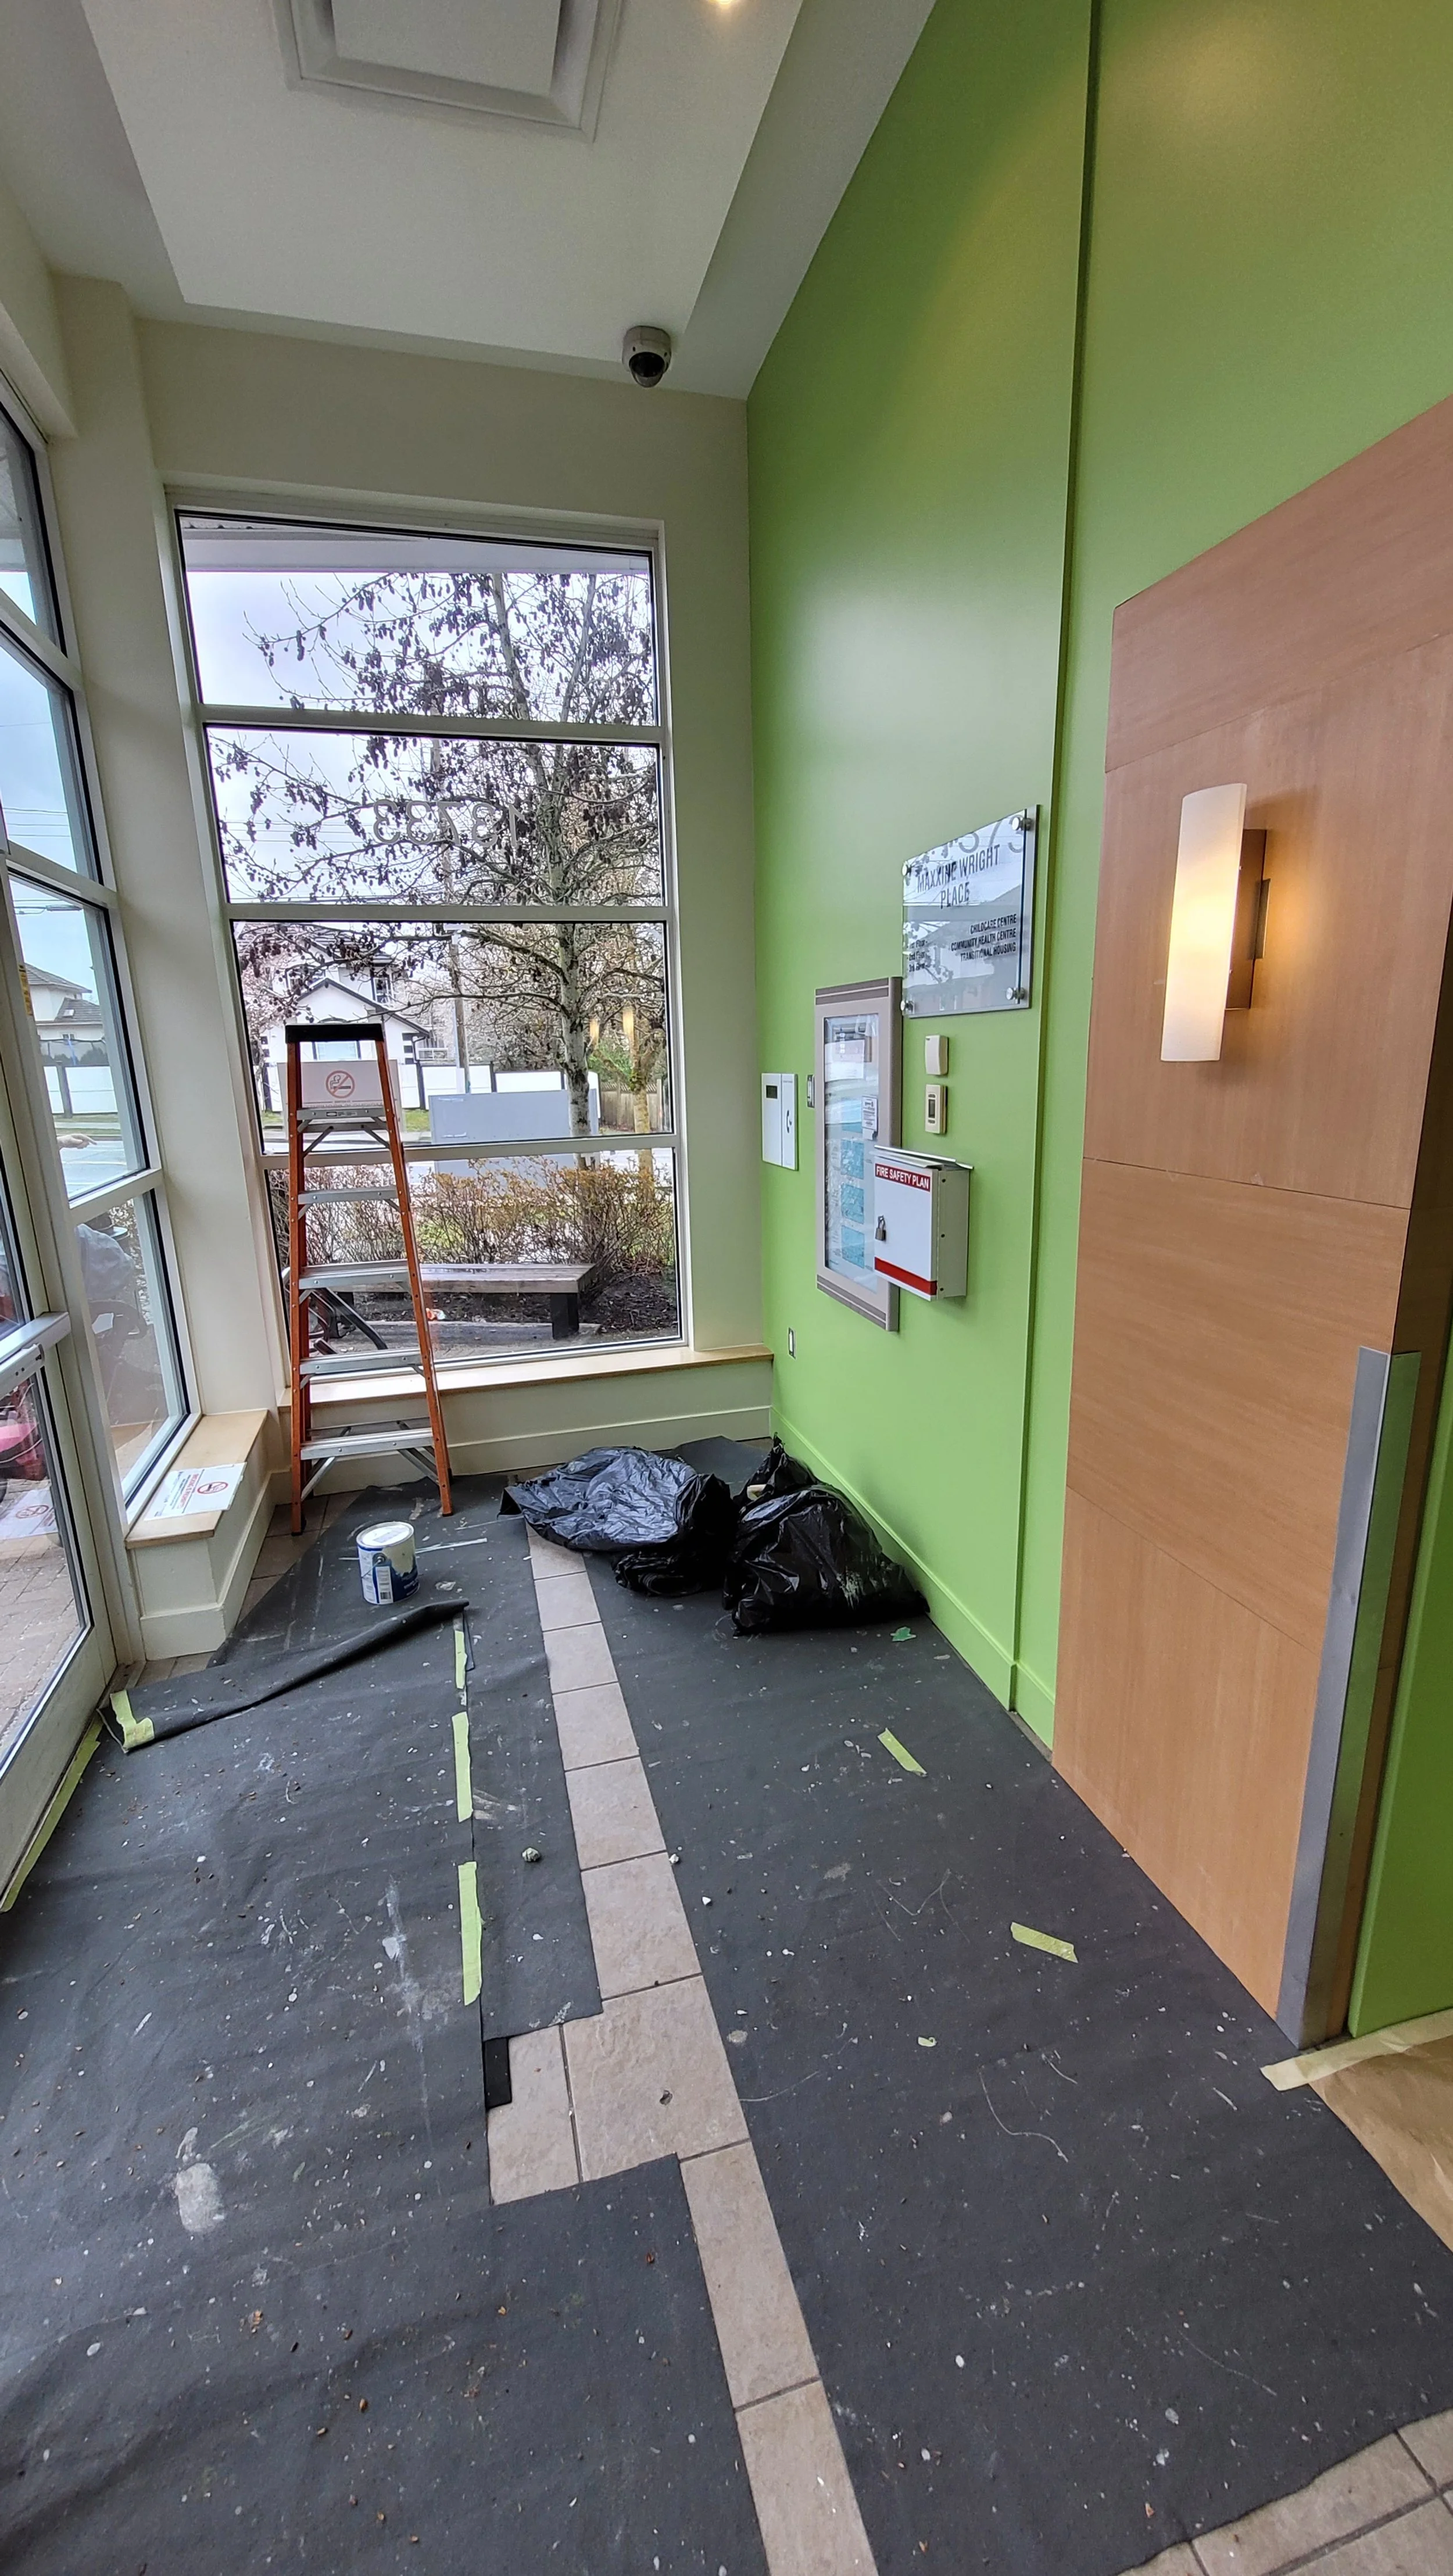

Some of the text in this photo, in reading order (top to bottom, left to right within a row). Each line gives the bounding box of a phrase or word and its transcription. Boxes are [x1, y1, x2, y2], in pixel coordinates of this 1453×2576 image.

[917, 844, 1000, 893] MAXXINE WRIGHT
[940, 882, 970, 909] PLACE
[970, 913, 1017, 934] CHILDCARE CENTRE
[951, 927, 1017, 951] COMMUNITY HEALTH CENTRE
[961, 942, 1016, 962] TRANSITIONAL HOUSING
[876, 1166, 929, 1190] FIRE SAFETY PLAN
